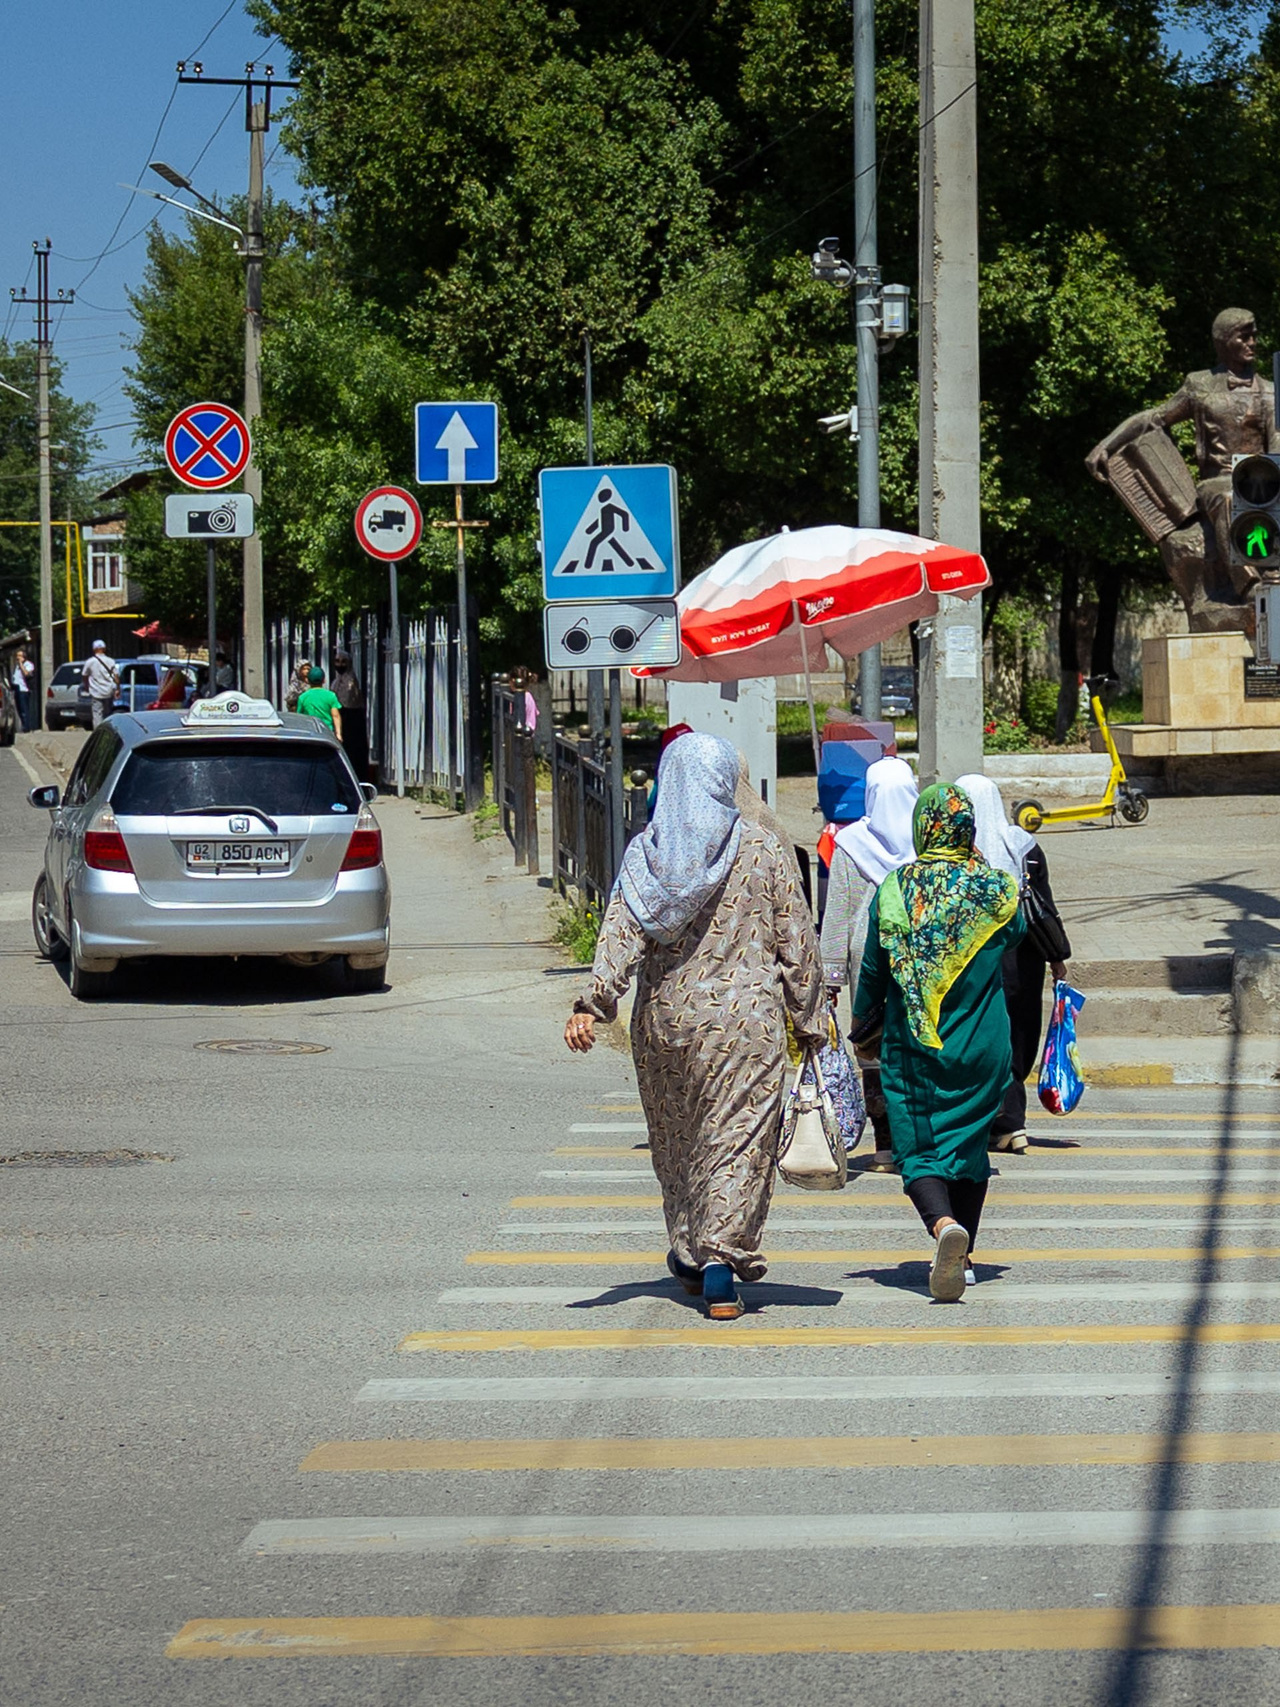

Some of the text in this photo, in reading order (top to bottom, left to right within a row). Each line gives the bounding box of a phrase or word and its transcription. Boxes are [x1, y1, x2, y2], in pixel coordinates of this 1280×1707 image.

[194, 844, 209, 855] 02
[221, 844, 253, 860] 850
[255, 847, 283, 860] ACN
